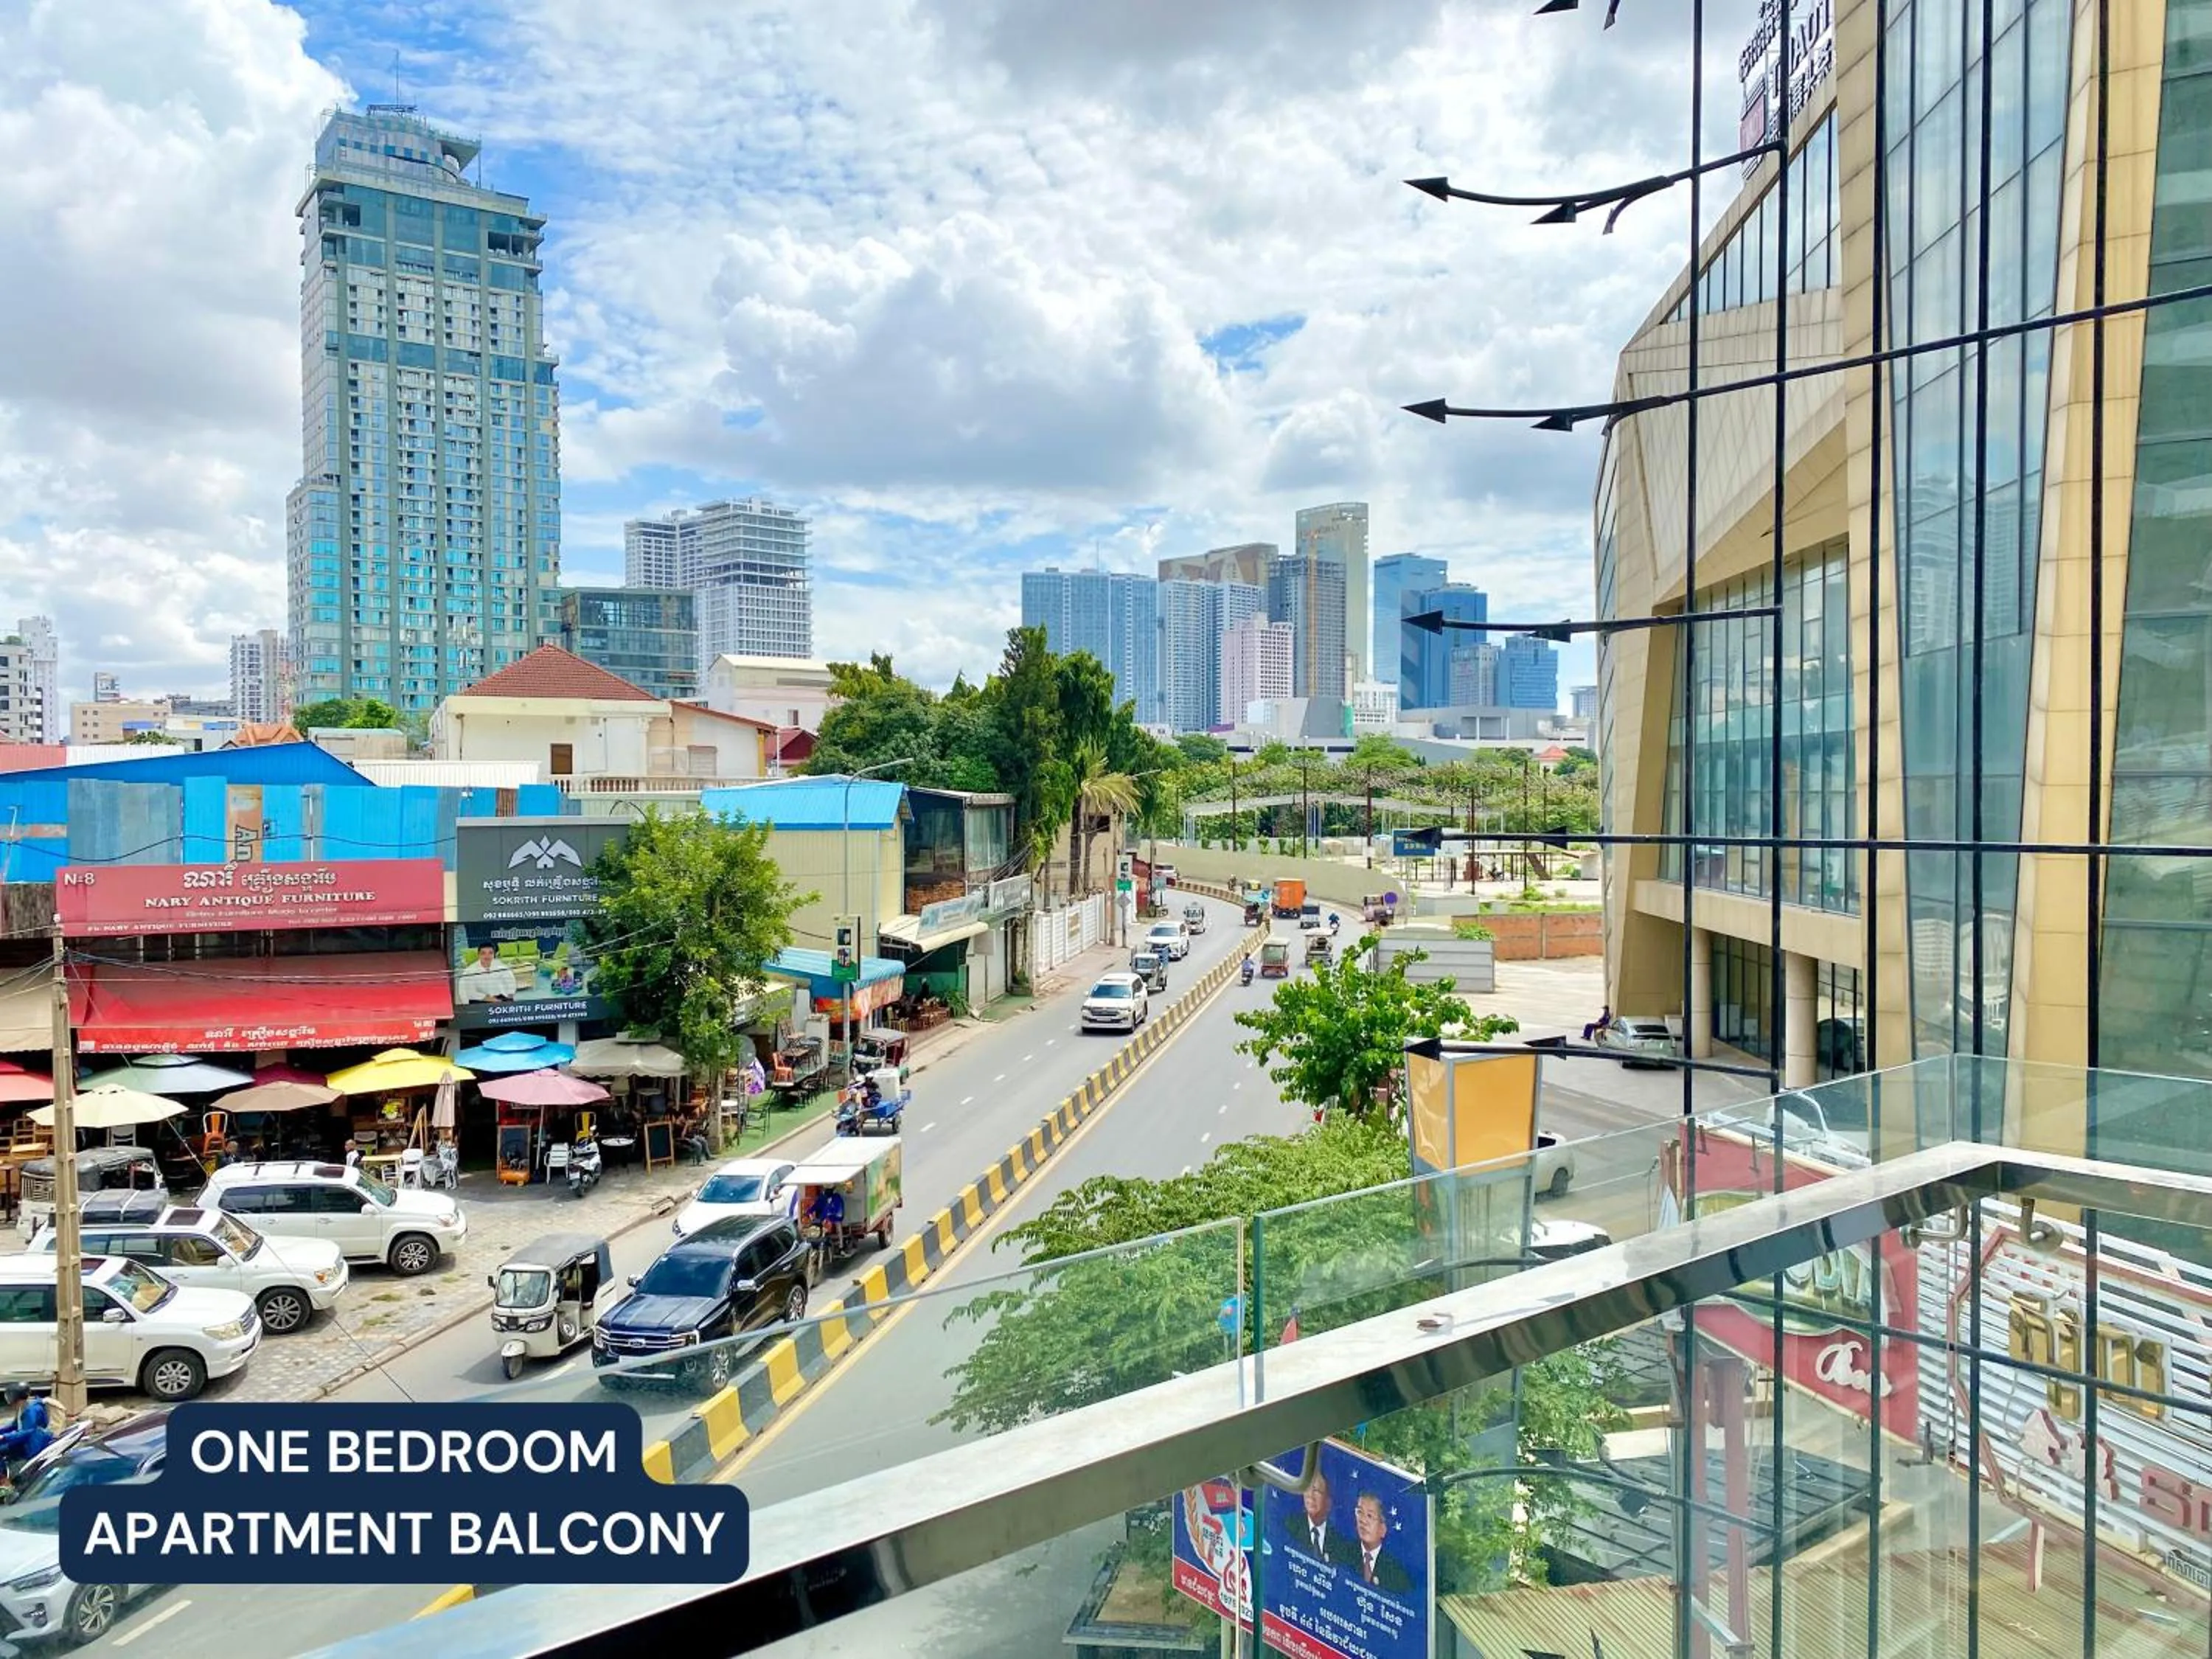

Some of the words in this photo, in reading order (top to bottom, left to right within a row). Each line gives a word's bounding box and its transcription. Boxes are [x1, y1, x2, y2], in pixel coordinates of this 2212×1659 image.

[145, 897, 192, 908] NARY
[199, 894, 274, 906] ANTIQUE
[282, 891, 376, 903] FURNITURE
[492, 896, 538, 905] SOKRITH
[542, 893, 598, 903] FURNITURE
[487, 1005, 532, 1015] SOKRITH
[535, 1001, 588, 1012] FURNITURE
